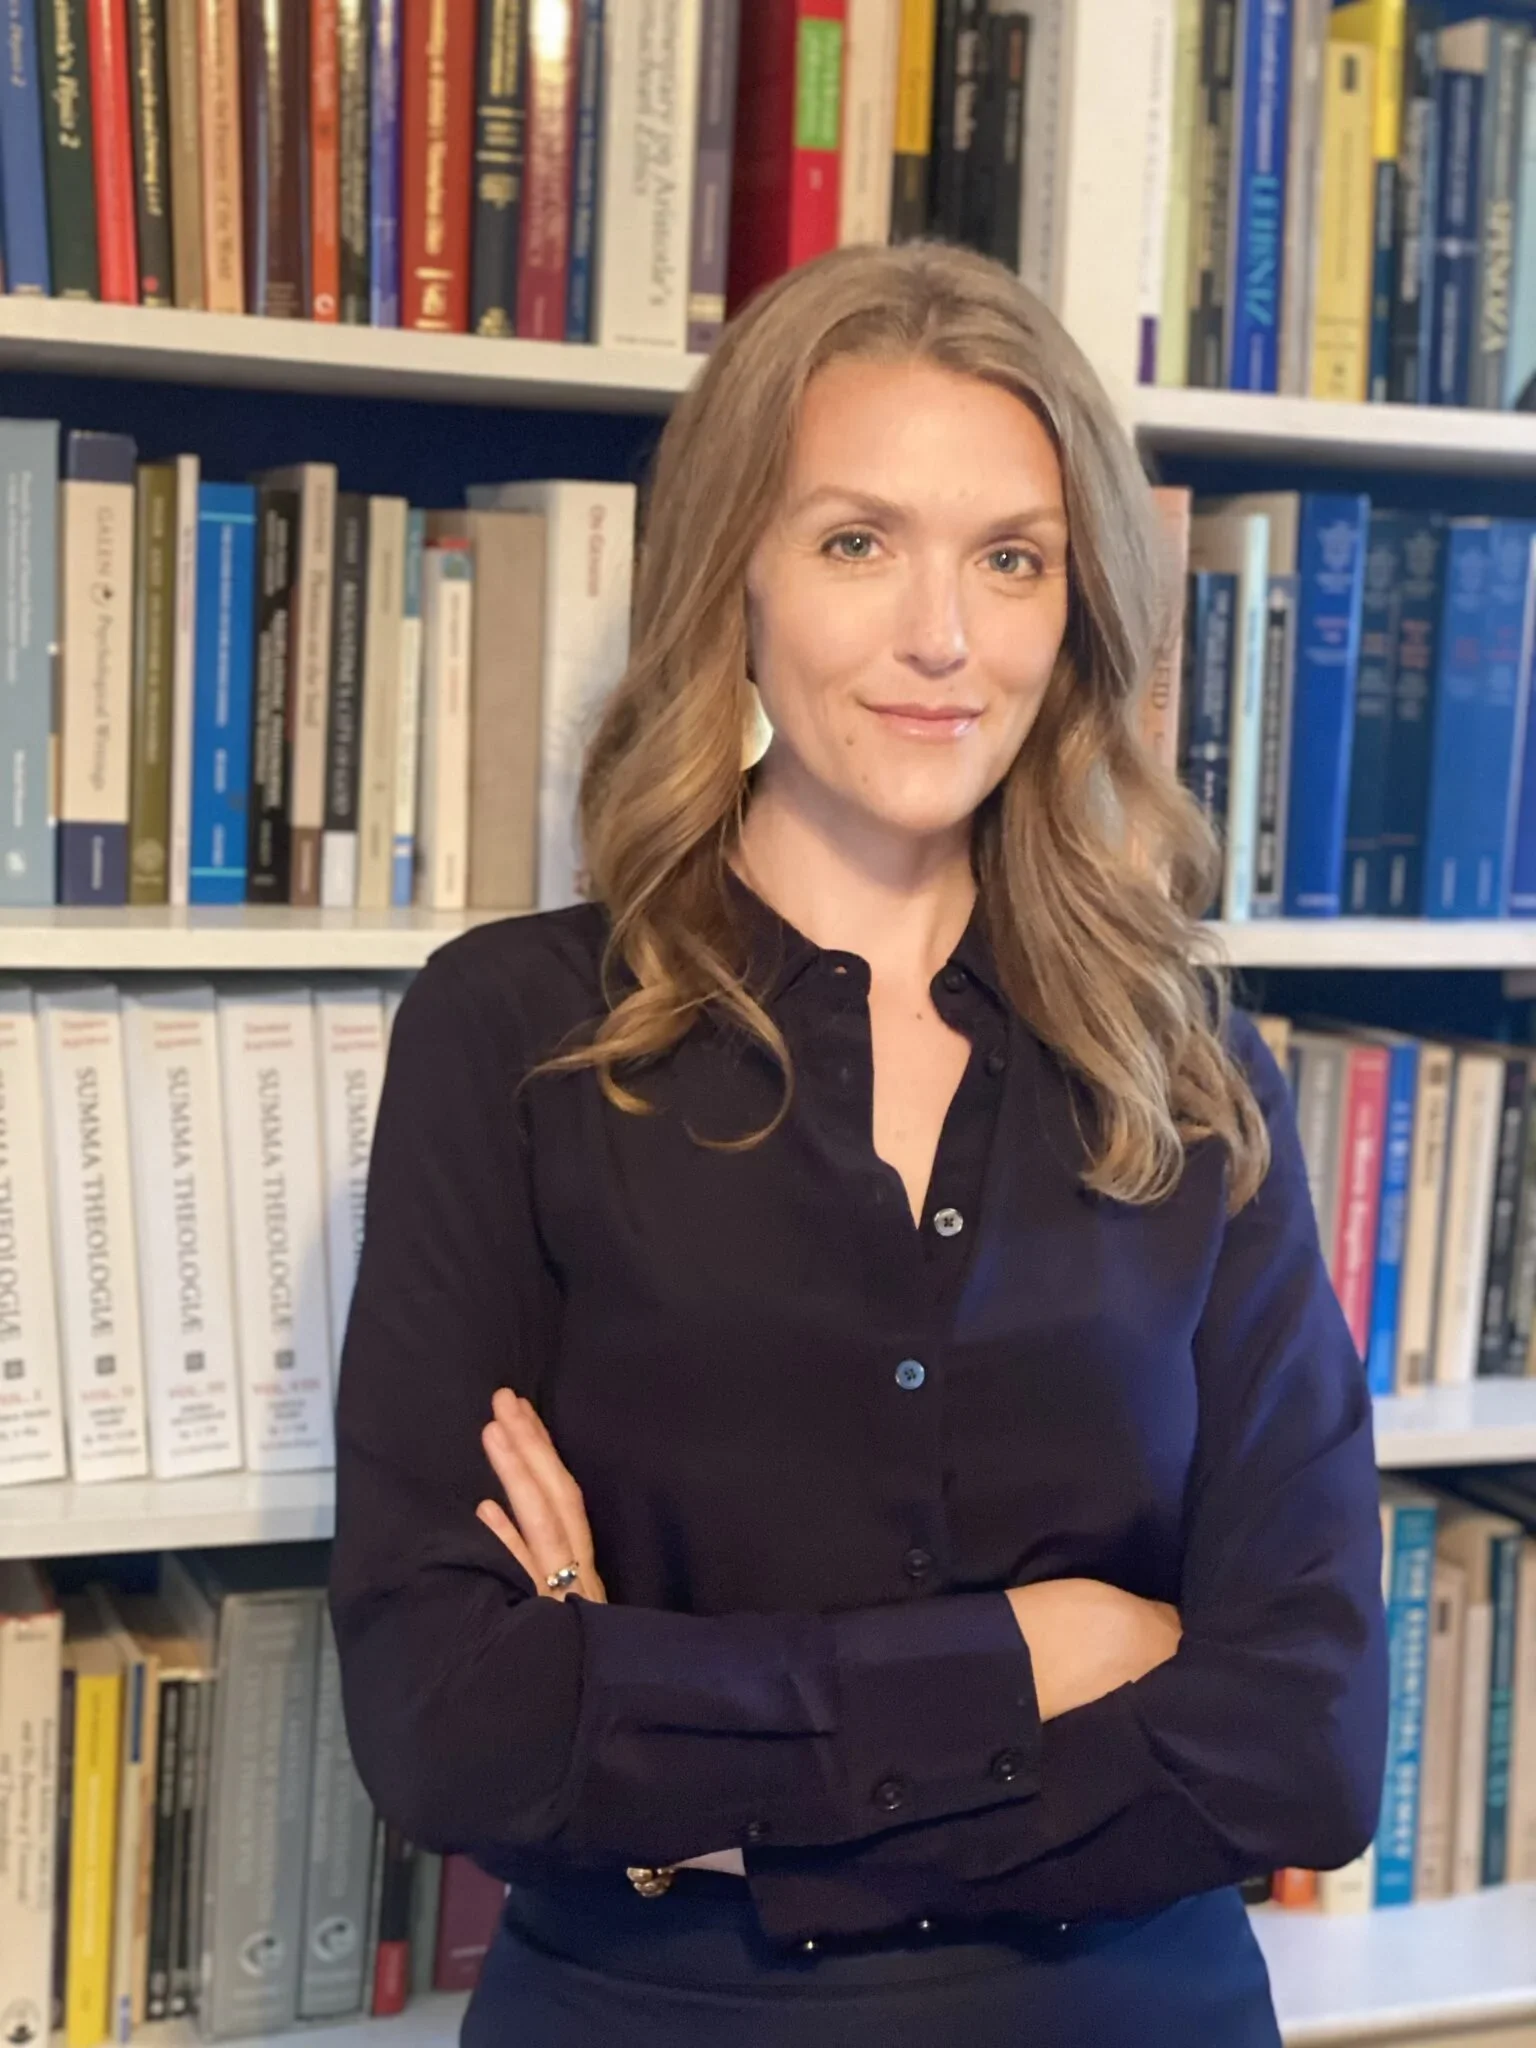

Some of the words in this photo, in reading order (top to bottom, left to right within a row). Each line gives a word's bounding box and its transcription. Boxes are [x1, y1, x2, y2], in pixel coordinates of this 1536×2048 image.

[1244, 175, 1279, 327] LEIBNIZ
[1482, 200, 1512, 353] SPINOZA
[75, 1065, 102, 1170] SUMMA
[167, 1065, 192, 1169] SUMMA
[258, 1066, 283, 1169] SUMMA
[346, 1067, 370, 1168] SUMMA
